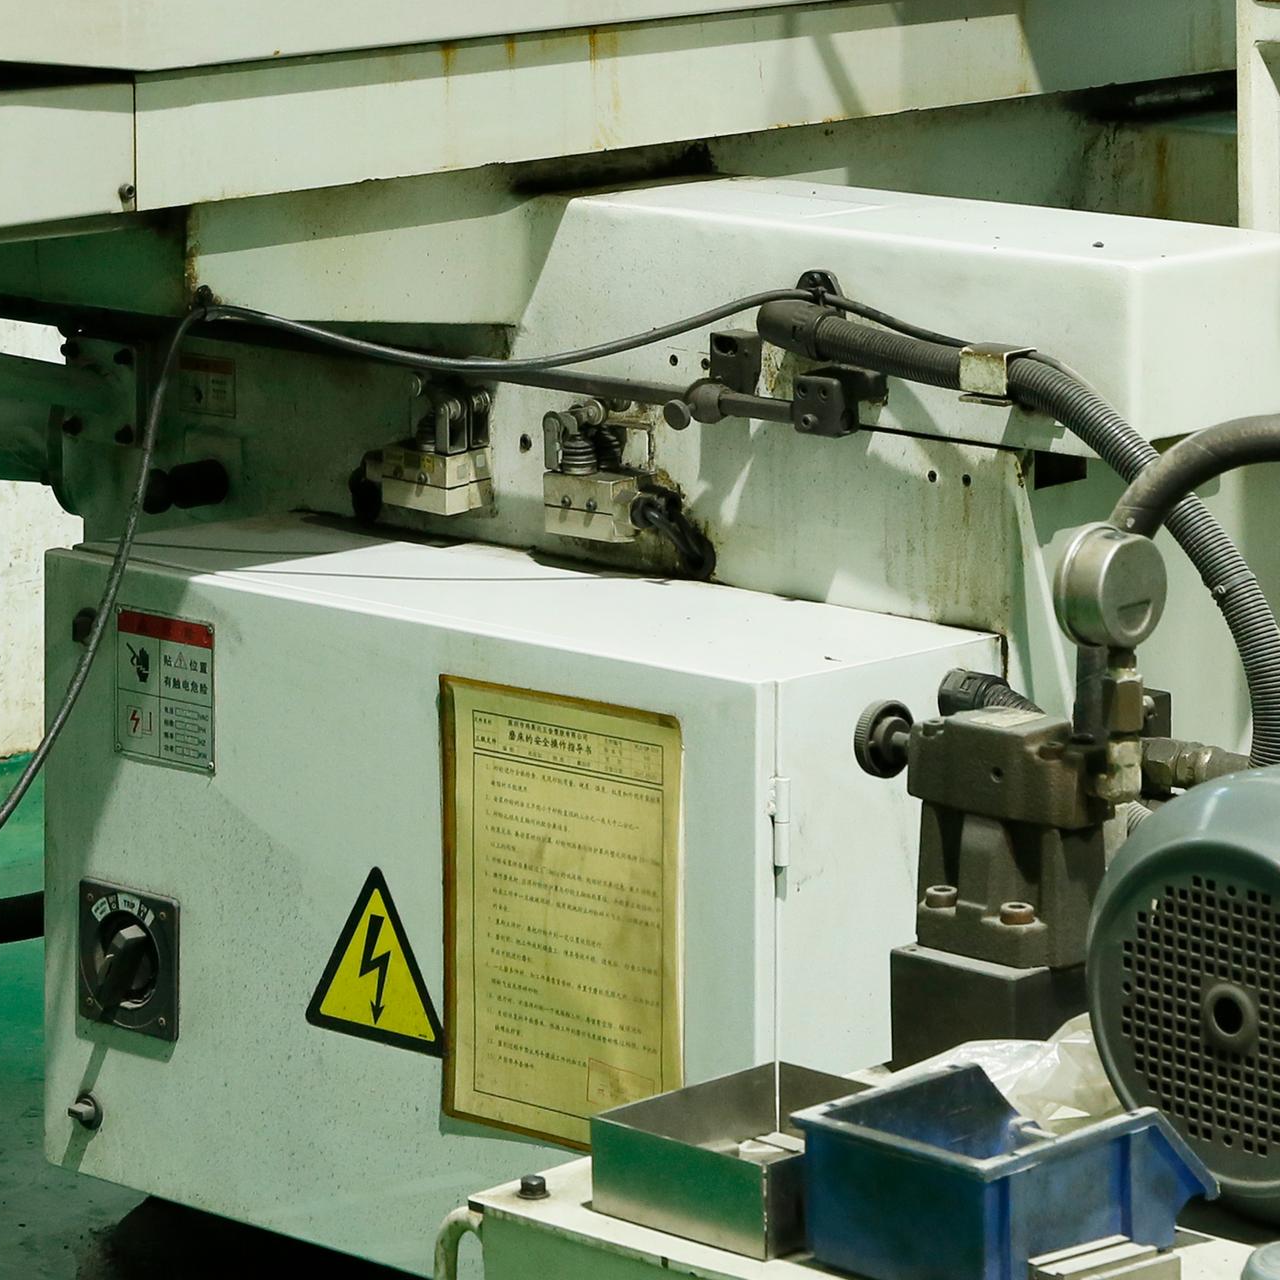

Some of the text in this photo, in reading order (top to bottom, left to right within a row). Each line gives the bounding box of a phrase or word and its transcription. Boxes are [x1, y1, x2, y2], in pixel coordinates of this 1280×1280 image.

[189, 659, 209, 675] 位置
[163, 675, 209, 696] 有触电危险
[508, 730, 593, 756] 磨床的安全操作指导书
